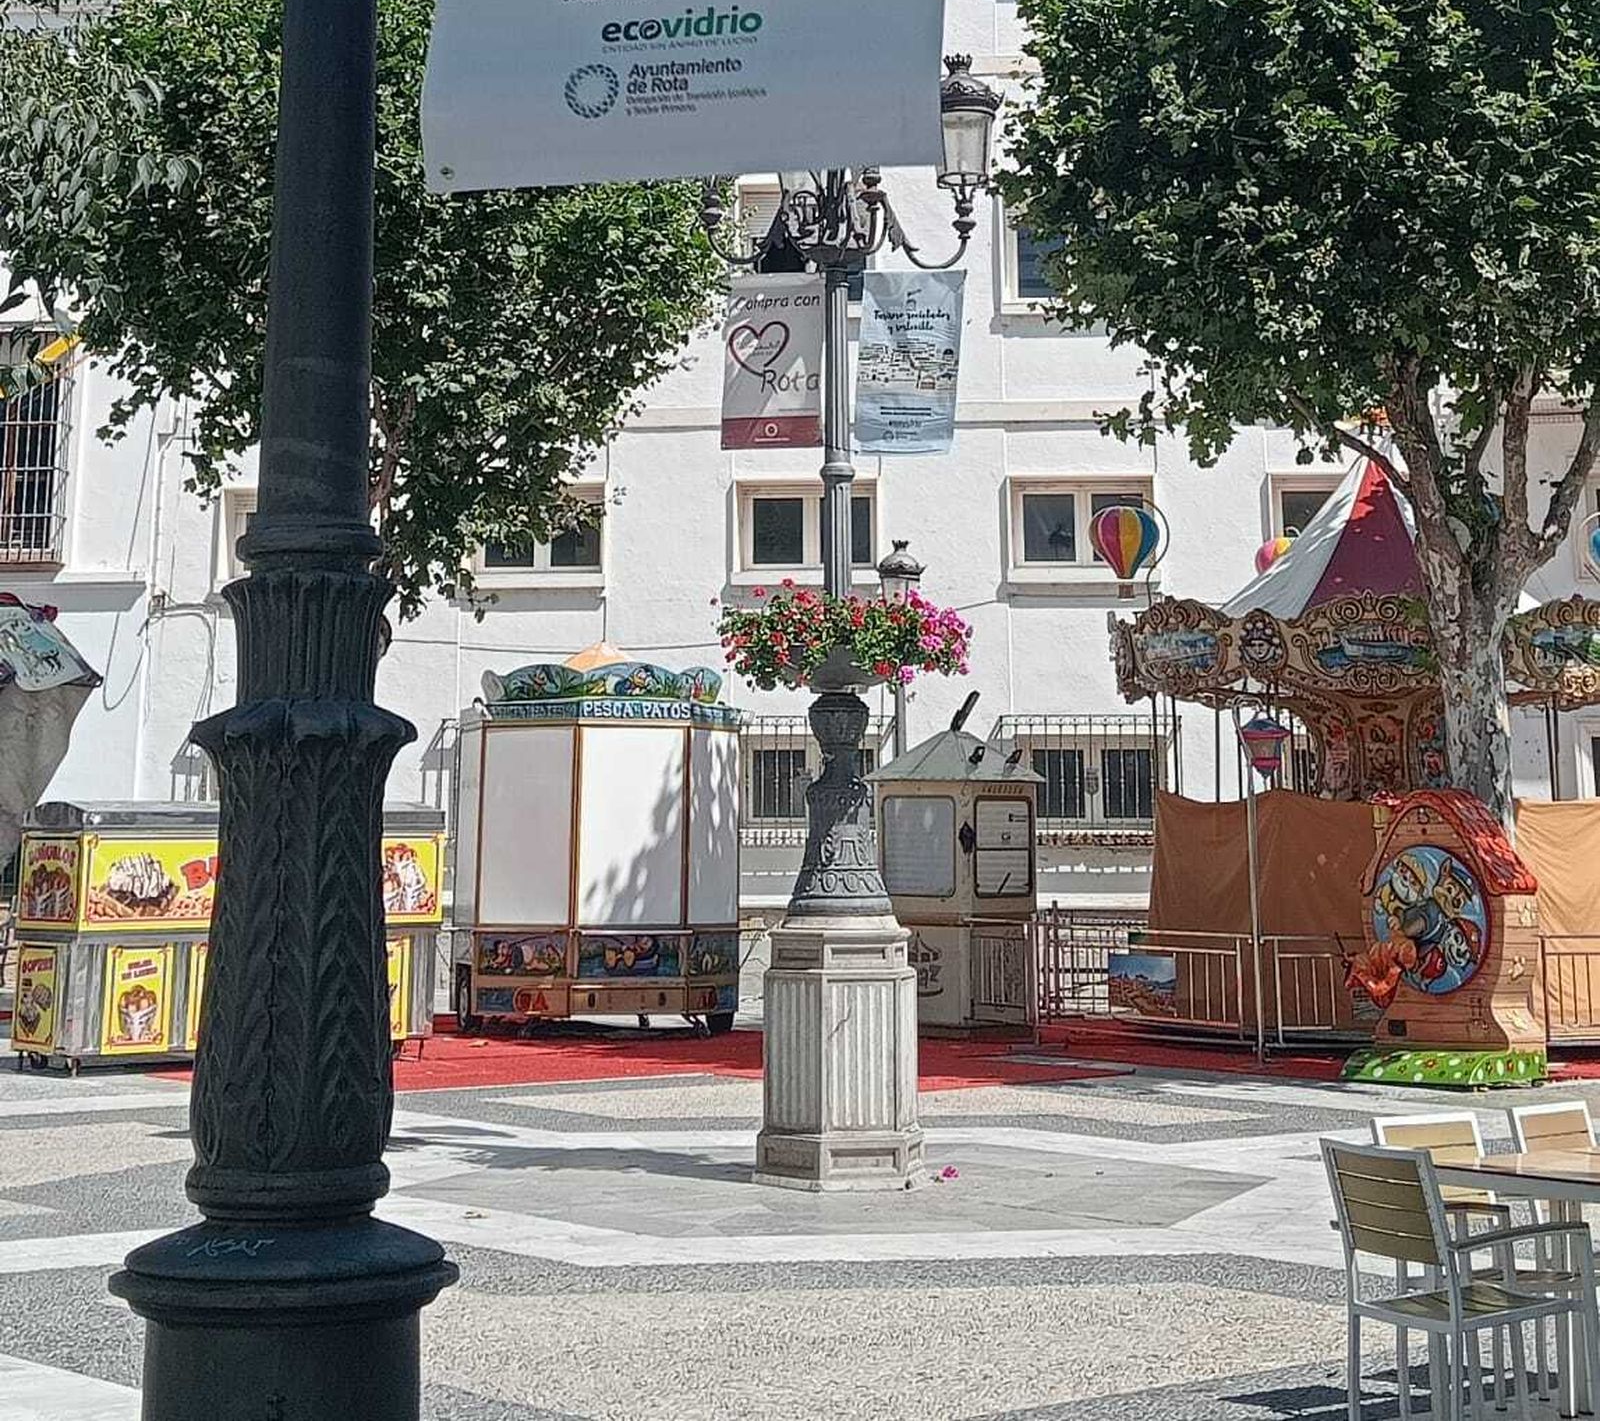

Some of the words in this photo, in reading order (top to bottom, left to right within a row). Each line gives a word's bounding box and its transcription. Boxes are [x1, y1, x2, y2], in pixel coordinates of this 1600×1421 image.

[601, 5, 763, 43] ecovidrio
[628, 58, 742, 80] Ayuntamiento
[626, 79, 647, 94] de
[651, 78, 689, 94] Rota
[794, 294, 820, 307] con
[761, 369, 820, 394] Rota
[642, 702, 691, 719] PATOS
